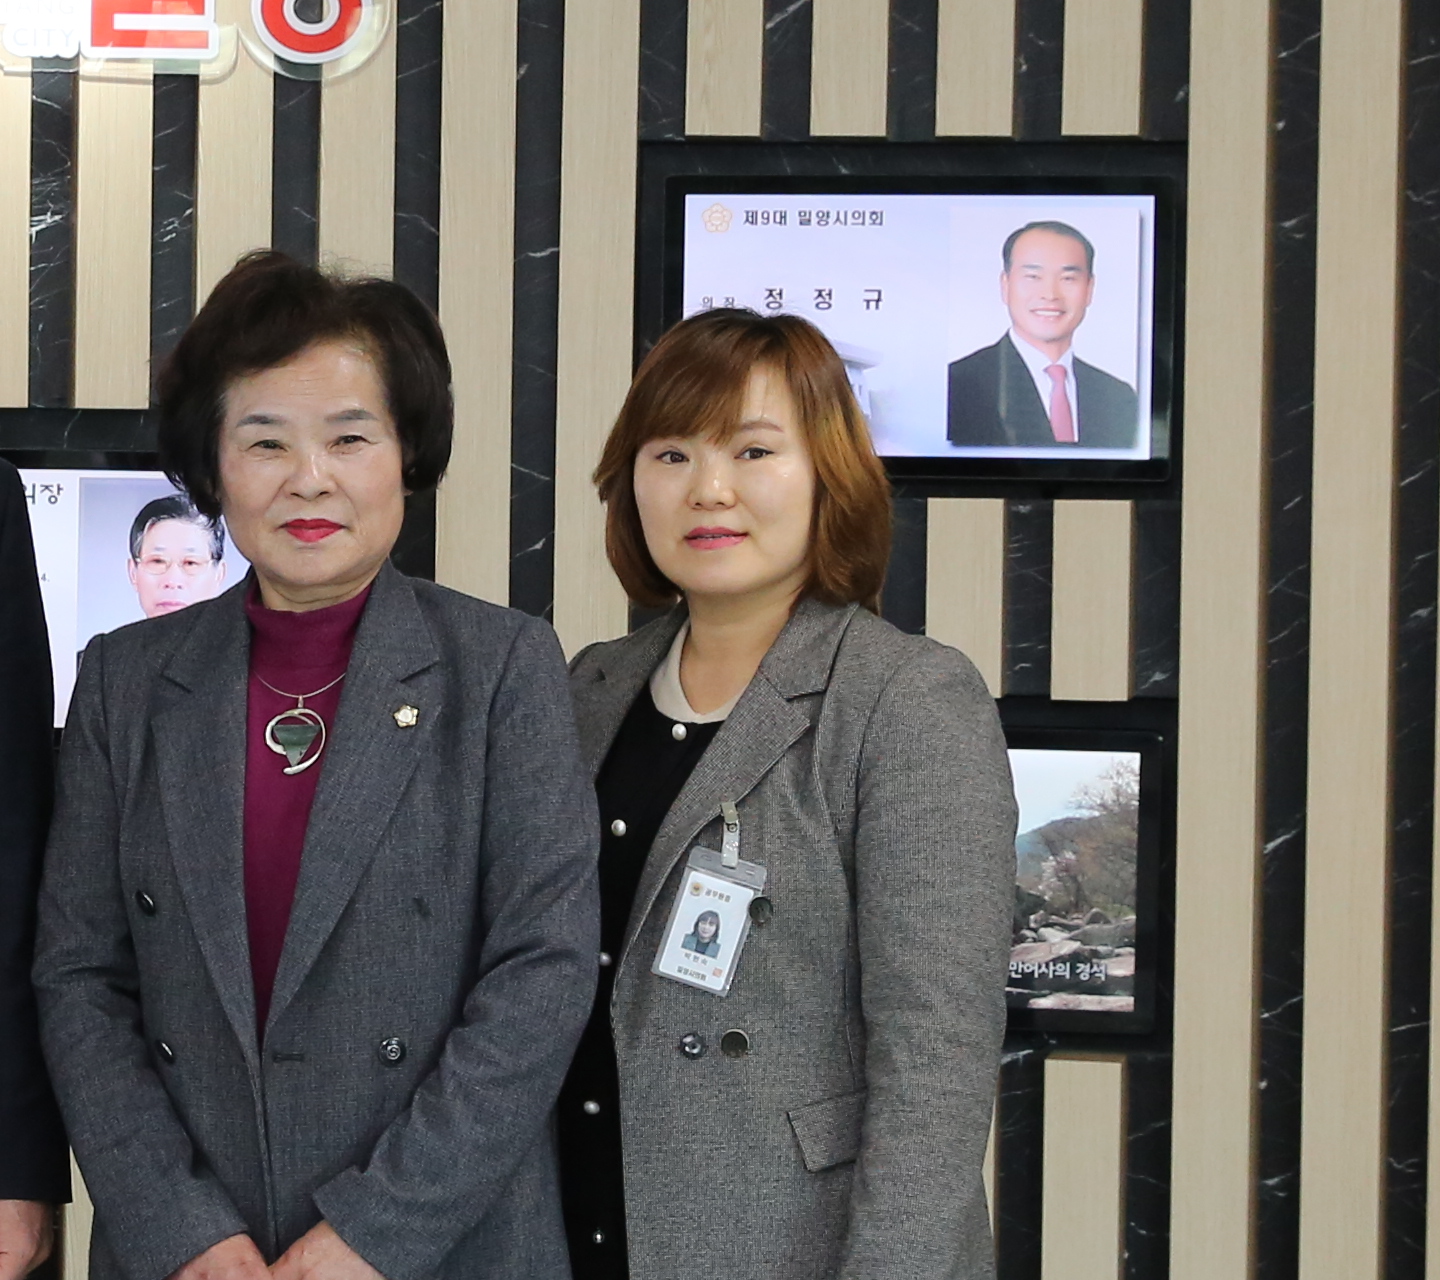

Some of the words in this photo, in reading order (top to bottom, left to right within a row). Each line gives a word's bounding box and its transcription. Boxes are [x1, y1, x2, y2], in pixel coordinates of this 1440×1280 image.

[13, 27, 75, 47] CITY
[743, 210, 788, 226] 제9대
[798, 210, 884, 227] 밀양시의회
[1075, 962, 1106, 981] 경석
